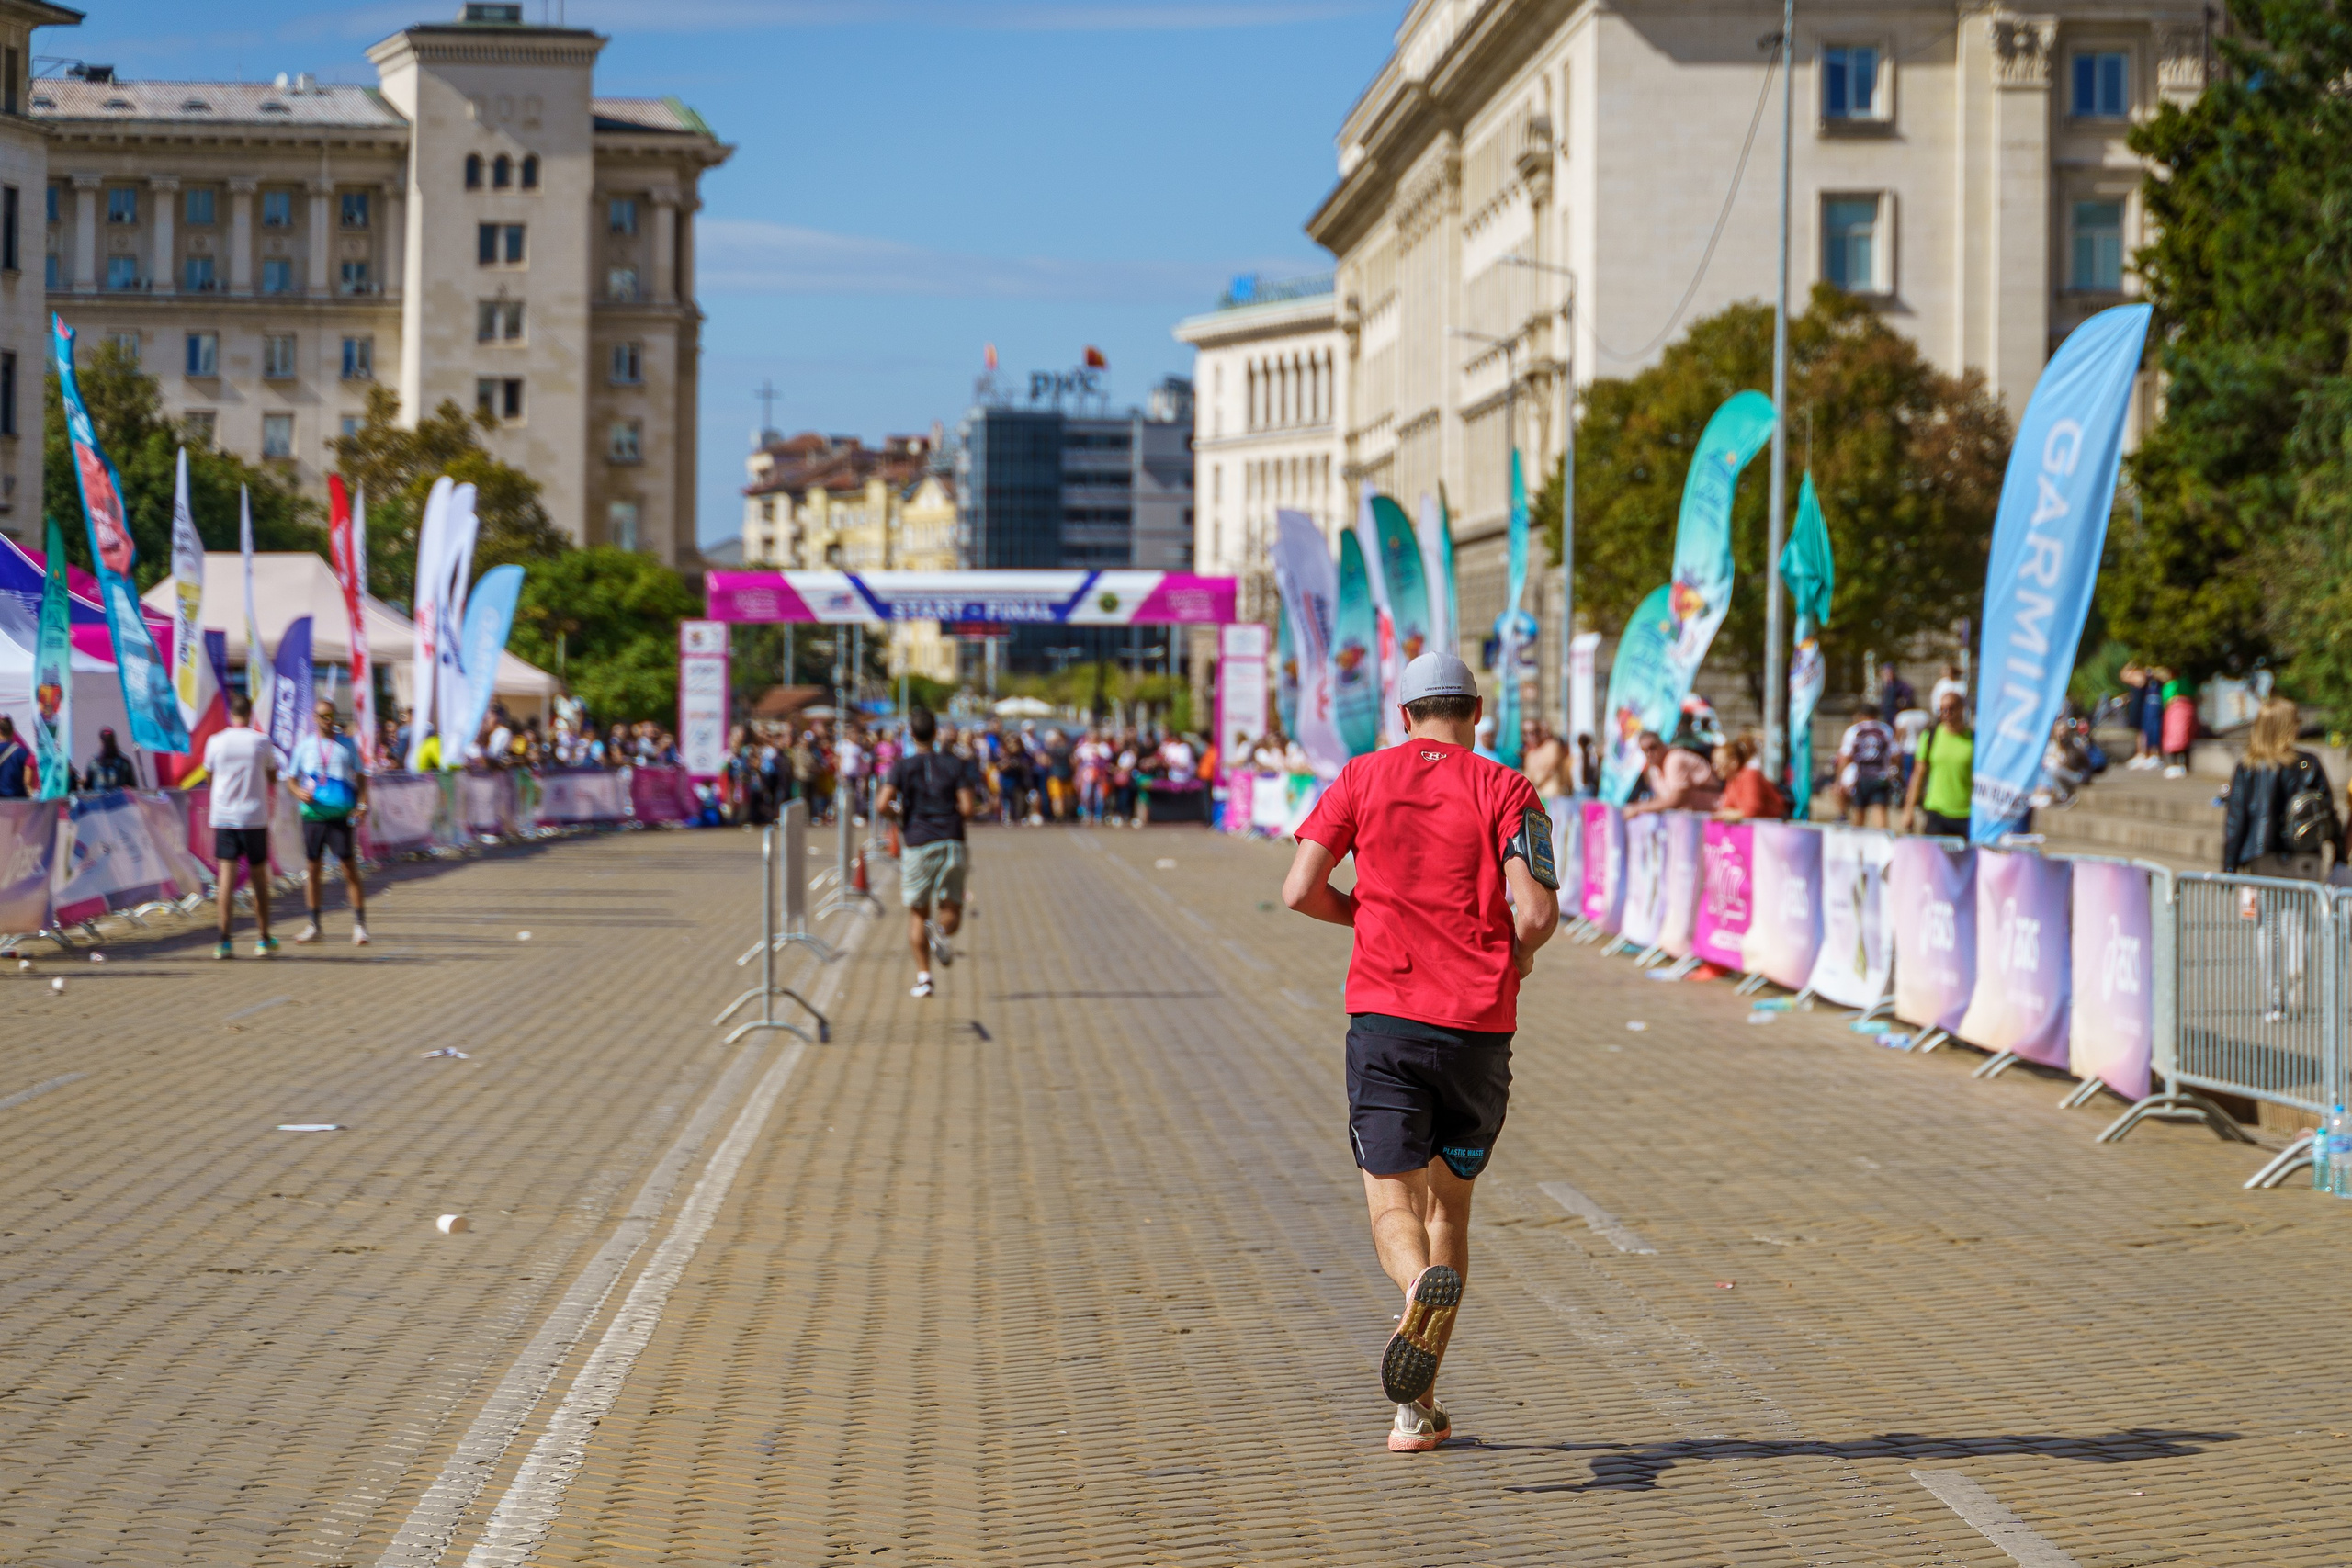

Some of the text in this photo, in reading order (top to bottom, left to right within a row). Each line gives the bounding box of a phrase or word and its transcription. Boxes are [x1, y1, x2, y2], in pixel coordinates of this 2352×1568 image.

[1996, 418, 2083, 743] GARMIN
[890, 599, 964, 622] START
[984, 599, 1057, 622] FINAL
[1442, 1146, 1484, 1157] PLASTIC WASTE
